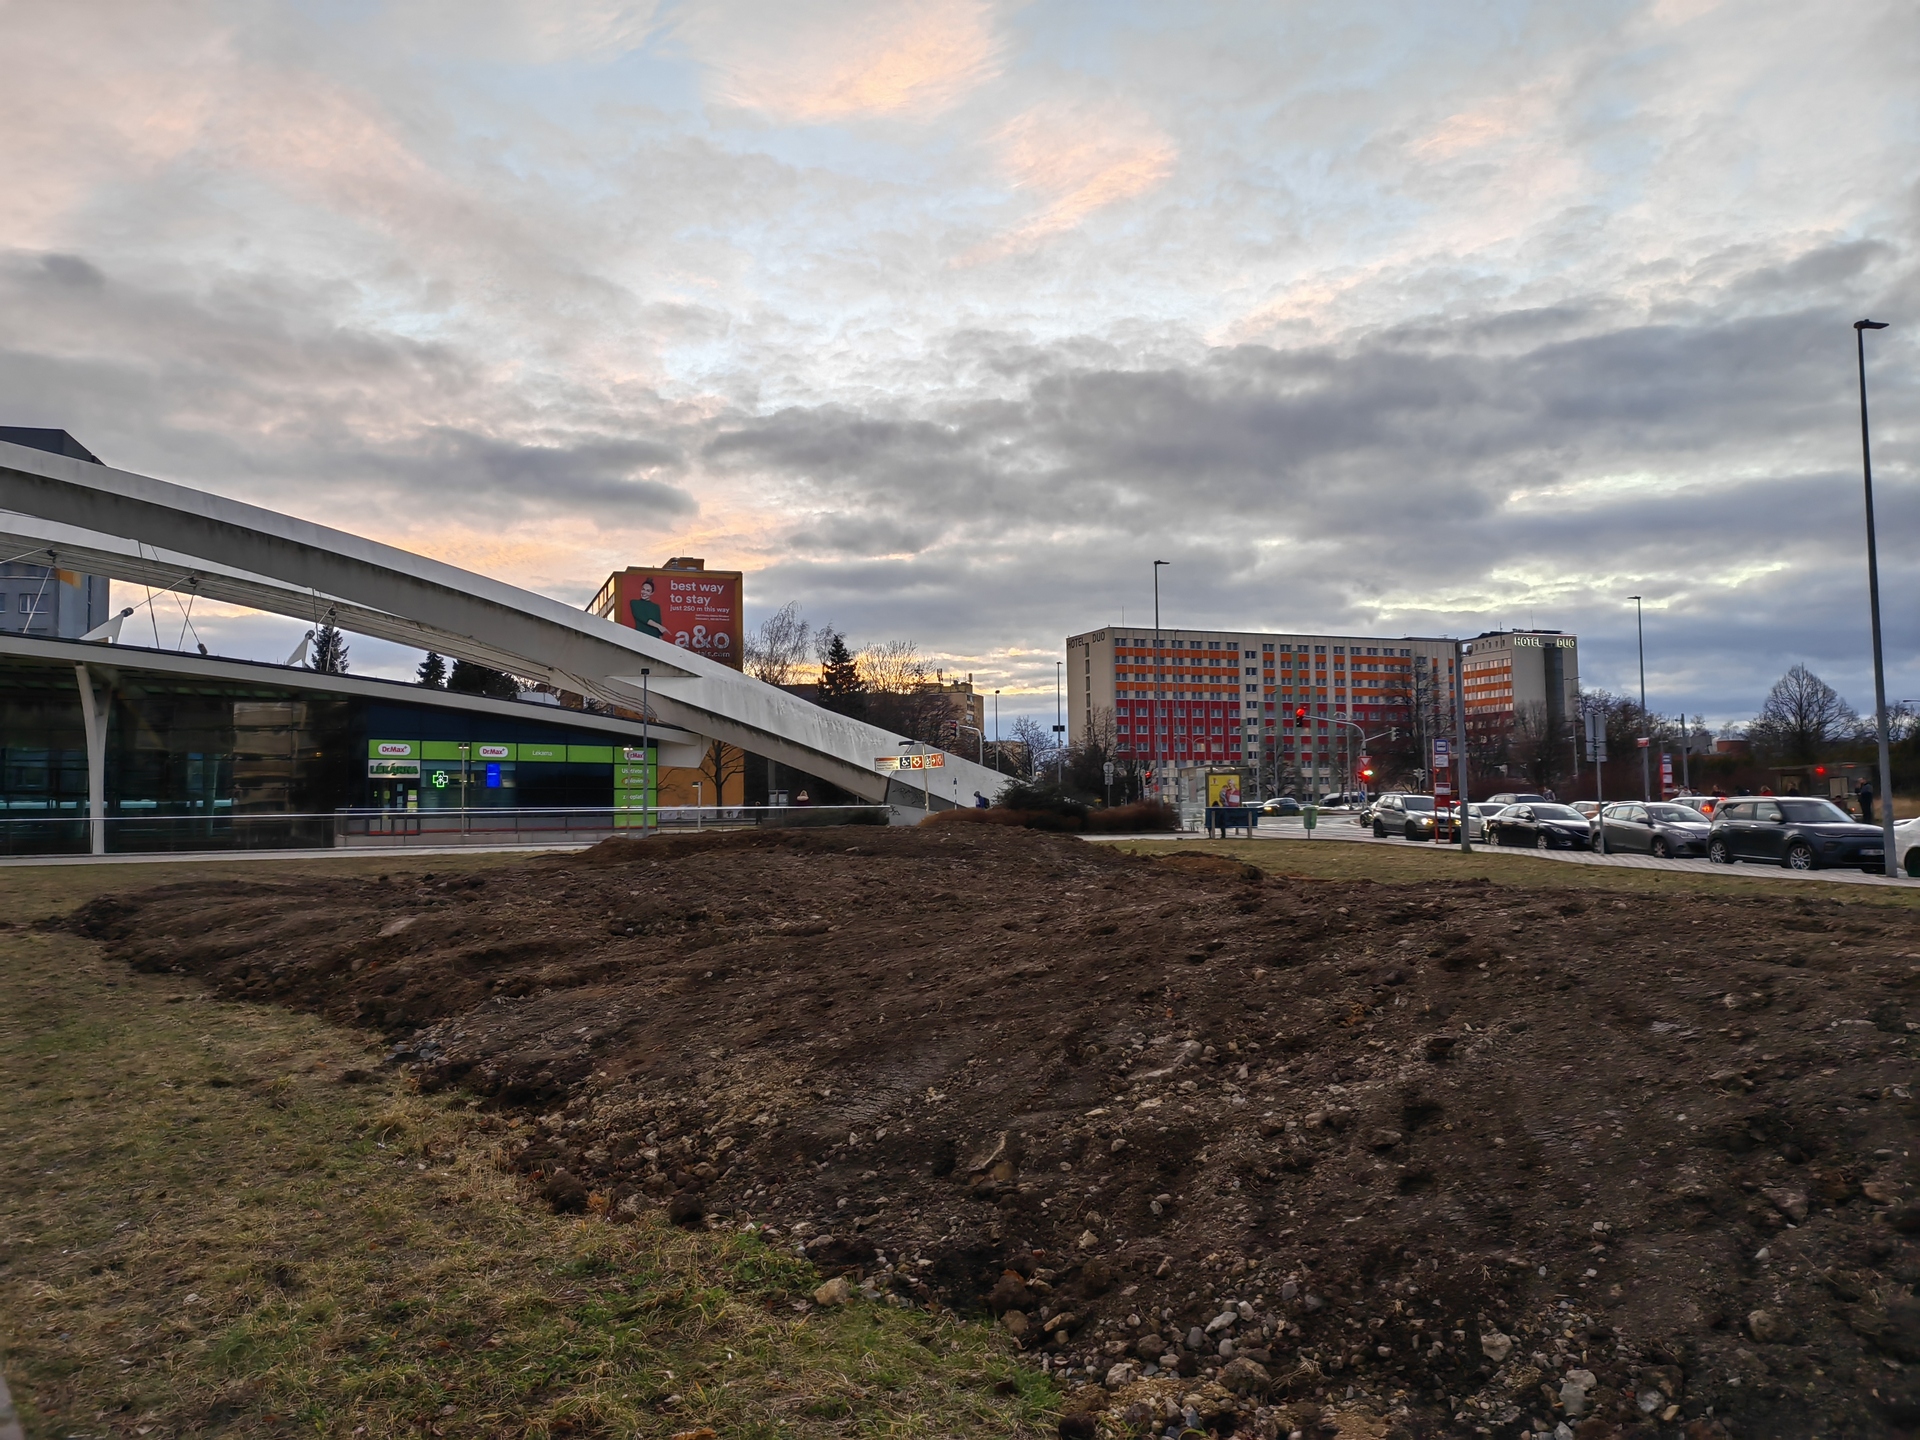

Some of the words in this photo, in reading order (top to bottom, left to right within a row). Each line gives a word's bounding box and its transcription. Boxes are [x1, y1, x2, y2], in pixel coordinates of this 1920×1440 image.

[670, 580, 696, 591] best
[699, 584, 724, 595] way
[670, 593, 683, 603] to
[686, 594, 711, 606] stay
[674, 624, 730, 649] a&o
[1067, 637, 1085, 649] HOTEL
[1092, 631, 1106, 643] DUO
[1514, 636, 1543, 647] HOTEL
[1556, 638, 1575, 648] DUO
